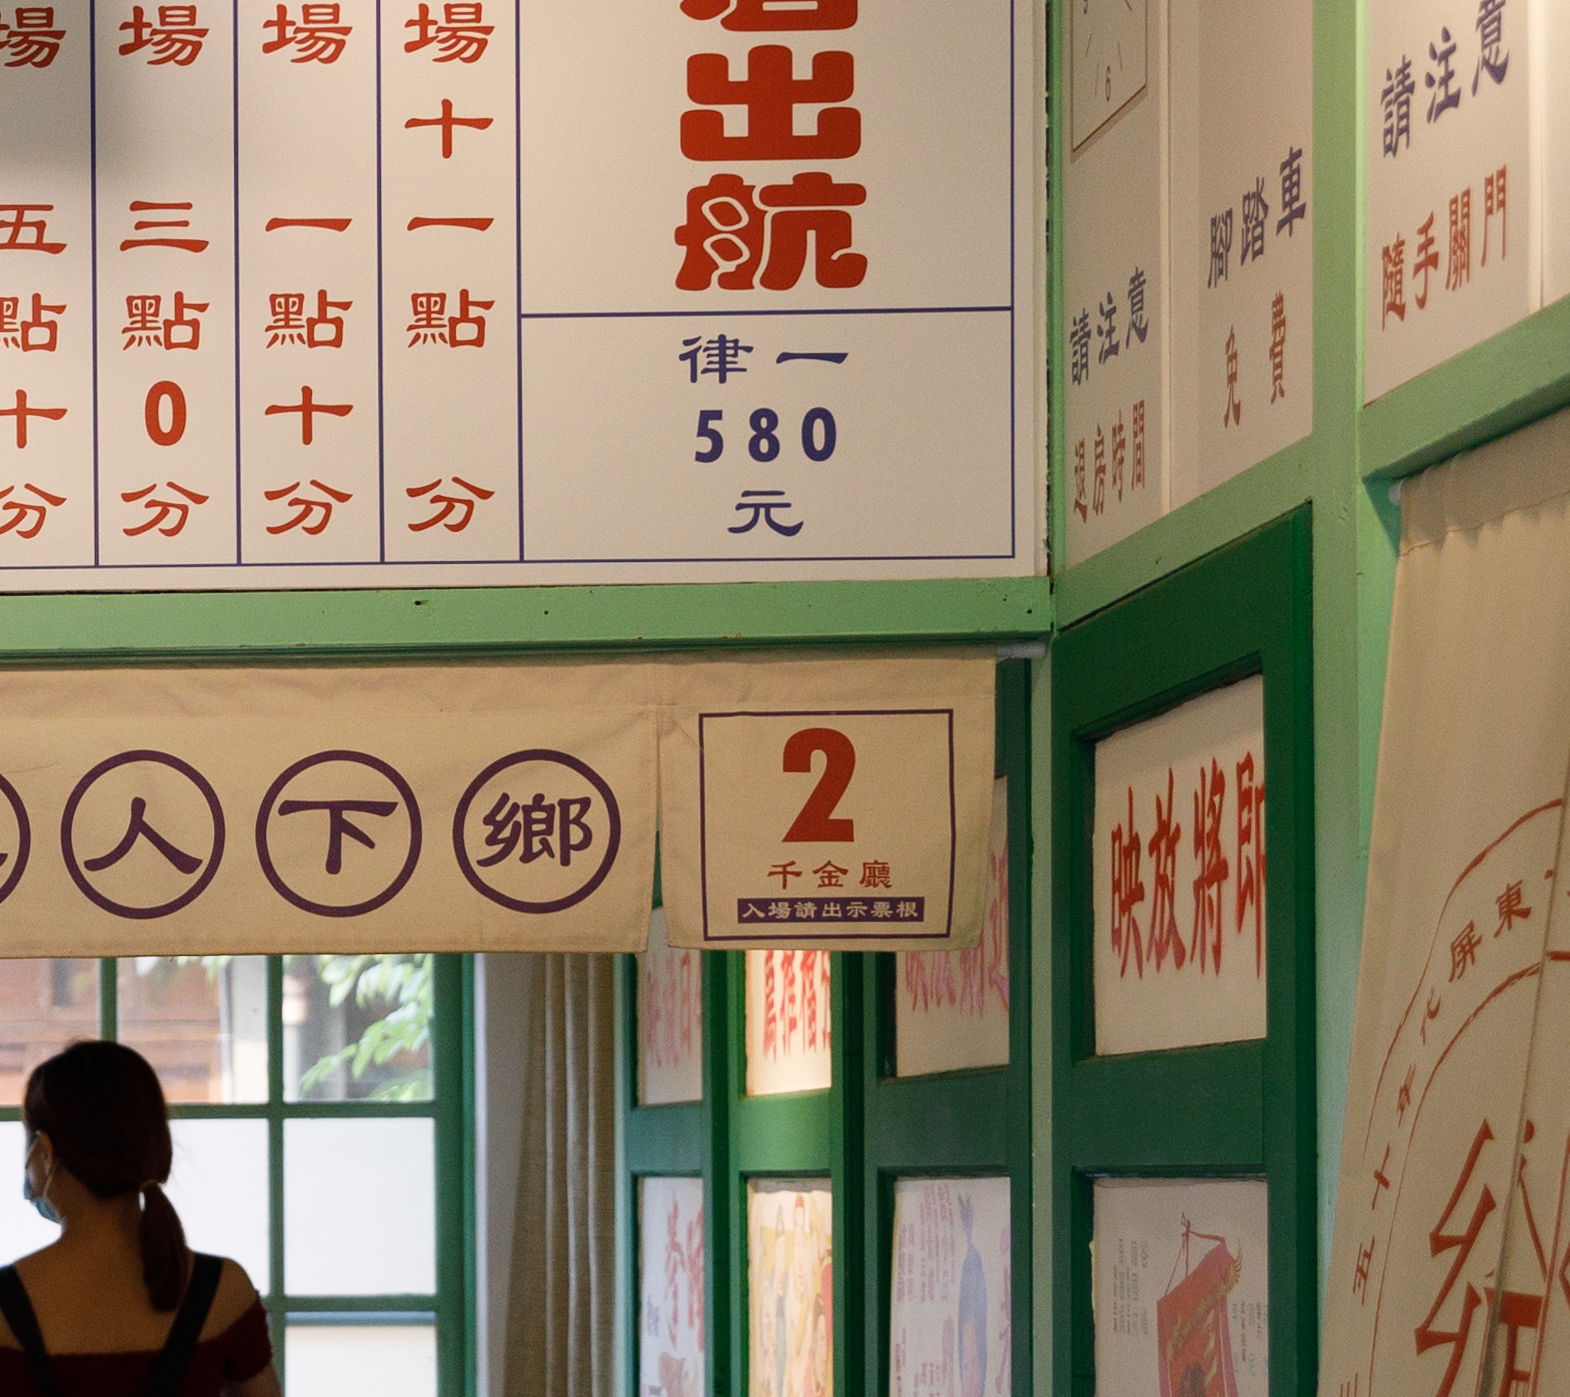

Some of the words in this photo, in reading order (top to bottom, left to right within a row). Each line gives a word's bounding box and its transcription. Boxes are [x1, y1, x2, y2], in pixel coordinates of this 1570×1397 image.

[1104, 65, 1112, 103] 6
[1207, 146, 1308, 290] 腳踏車
[1380, 164, 1510, 332] 隨手關門
[1069, 266, 1151, 386] 請注意
[1223, 291, 1288, 431] 免費
[694, 405, 838, 466] 580
[723, 487, 806, 541] 元
[781, 727, 855, 843] 2
[741, 900, 919, 919] 入場請出示票根
[767, 859, 893, 890] 千金廳
